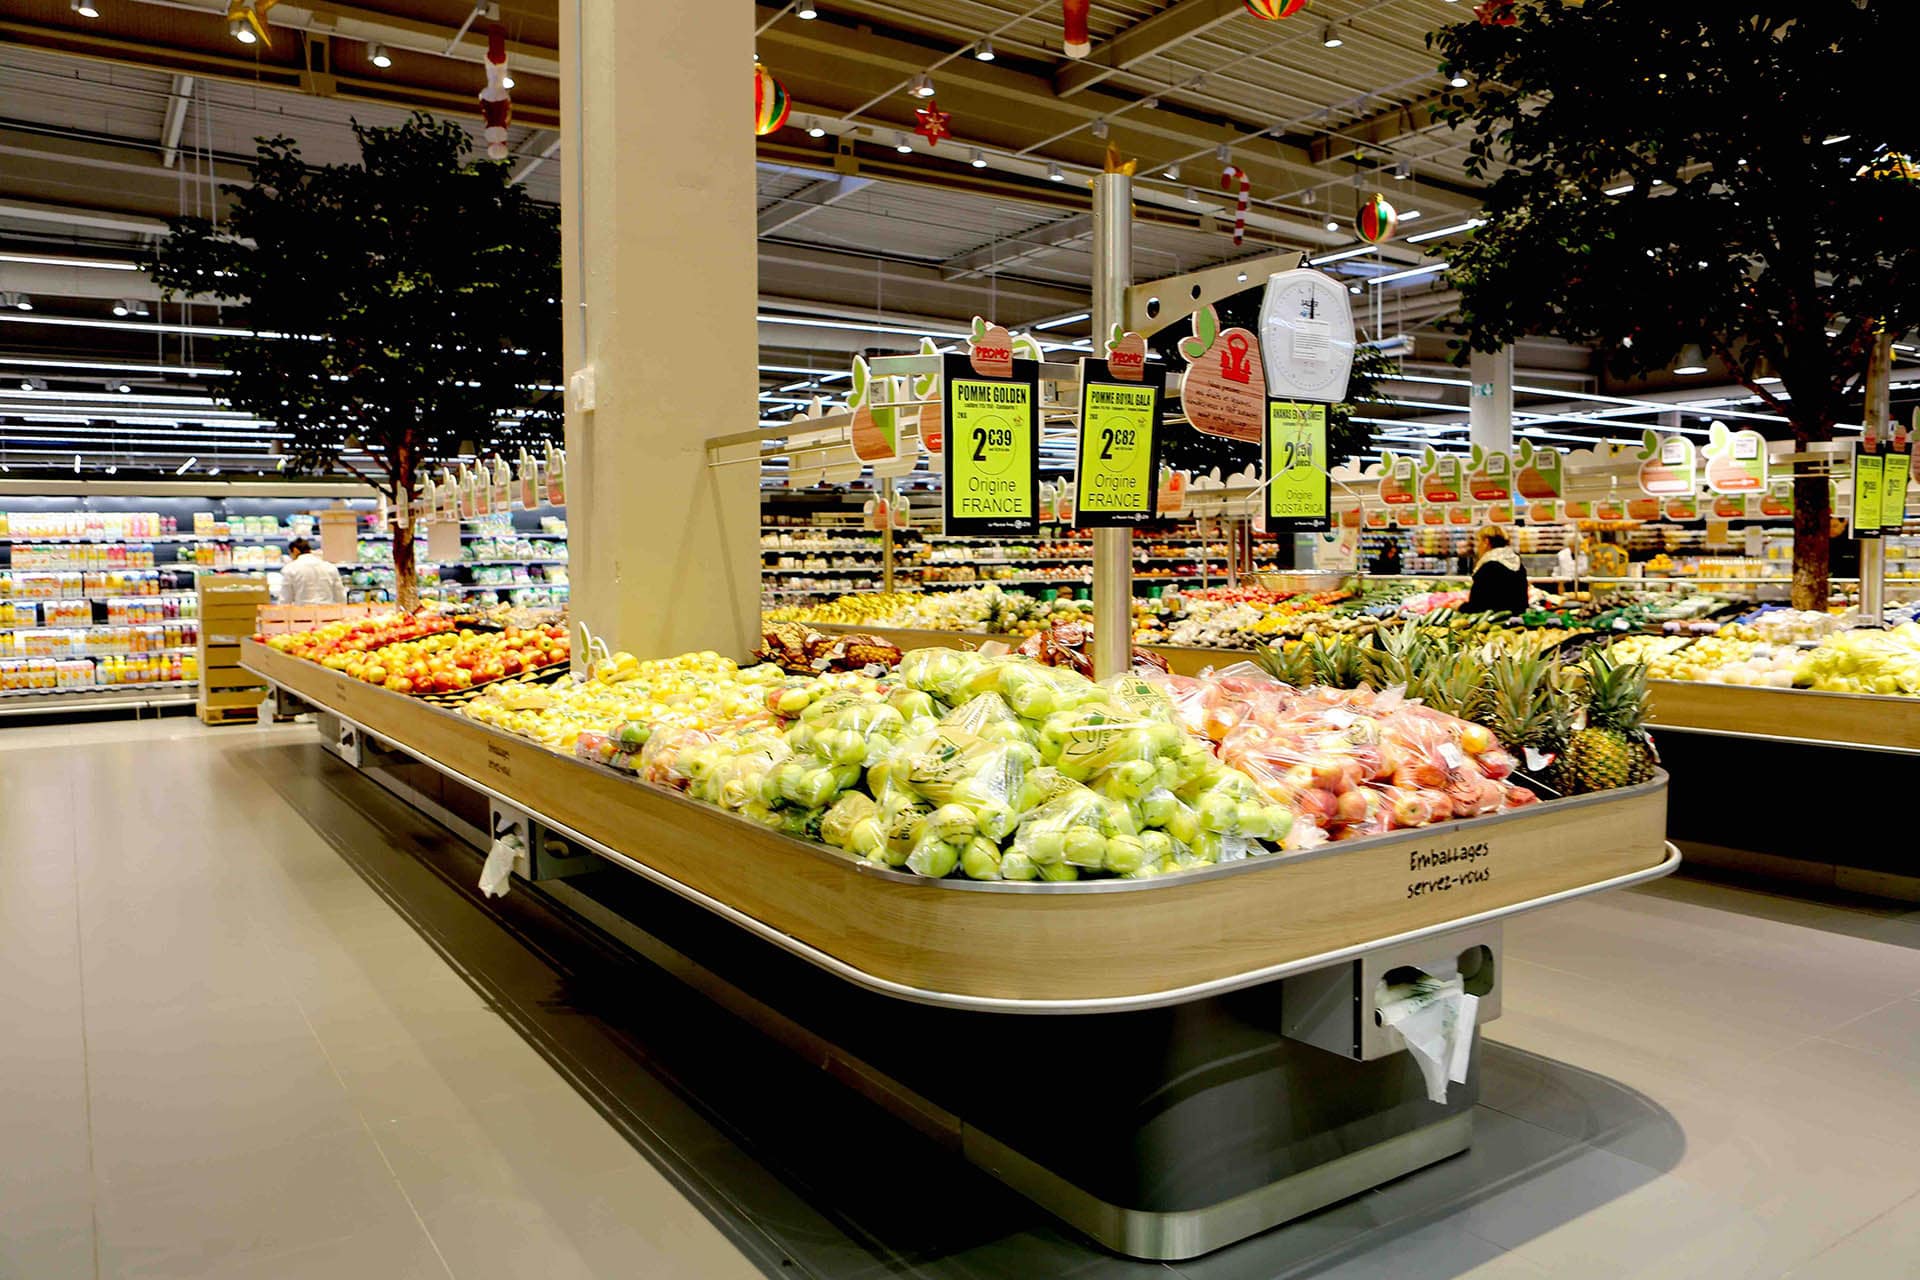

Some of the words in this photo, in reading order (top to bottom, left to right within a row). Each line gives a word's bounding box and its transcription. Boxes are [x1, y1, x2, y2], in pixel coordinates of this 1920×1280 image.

[975, 346, 1009, 359] PROMO
[958, 385, 991, 402] POMME
[993, 388, 1027, 404] GOLDEN
[1091, 391, 1115, 404] POMME
[1116, 393, 1134, 405] ROYAL
[1136, 395, 1151, 406] GALA
[968, 476, 1016, 496] Origine
[1095, 473, 1137, 492] Origine
[1088, 493, 1141, 508] FRANCE
[1287, 489, 1312, 503] Origine
[962, 497, 1023, 513] FRANCE
[1274, 503, 1303, 514] COSTA
[1304, 503, 1324, 514] RICA
[1410, 843, 1489, 872] Emballages
[1407, 867, 1490, 899] servez-vous
